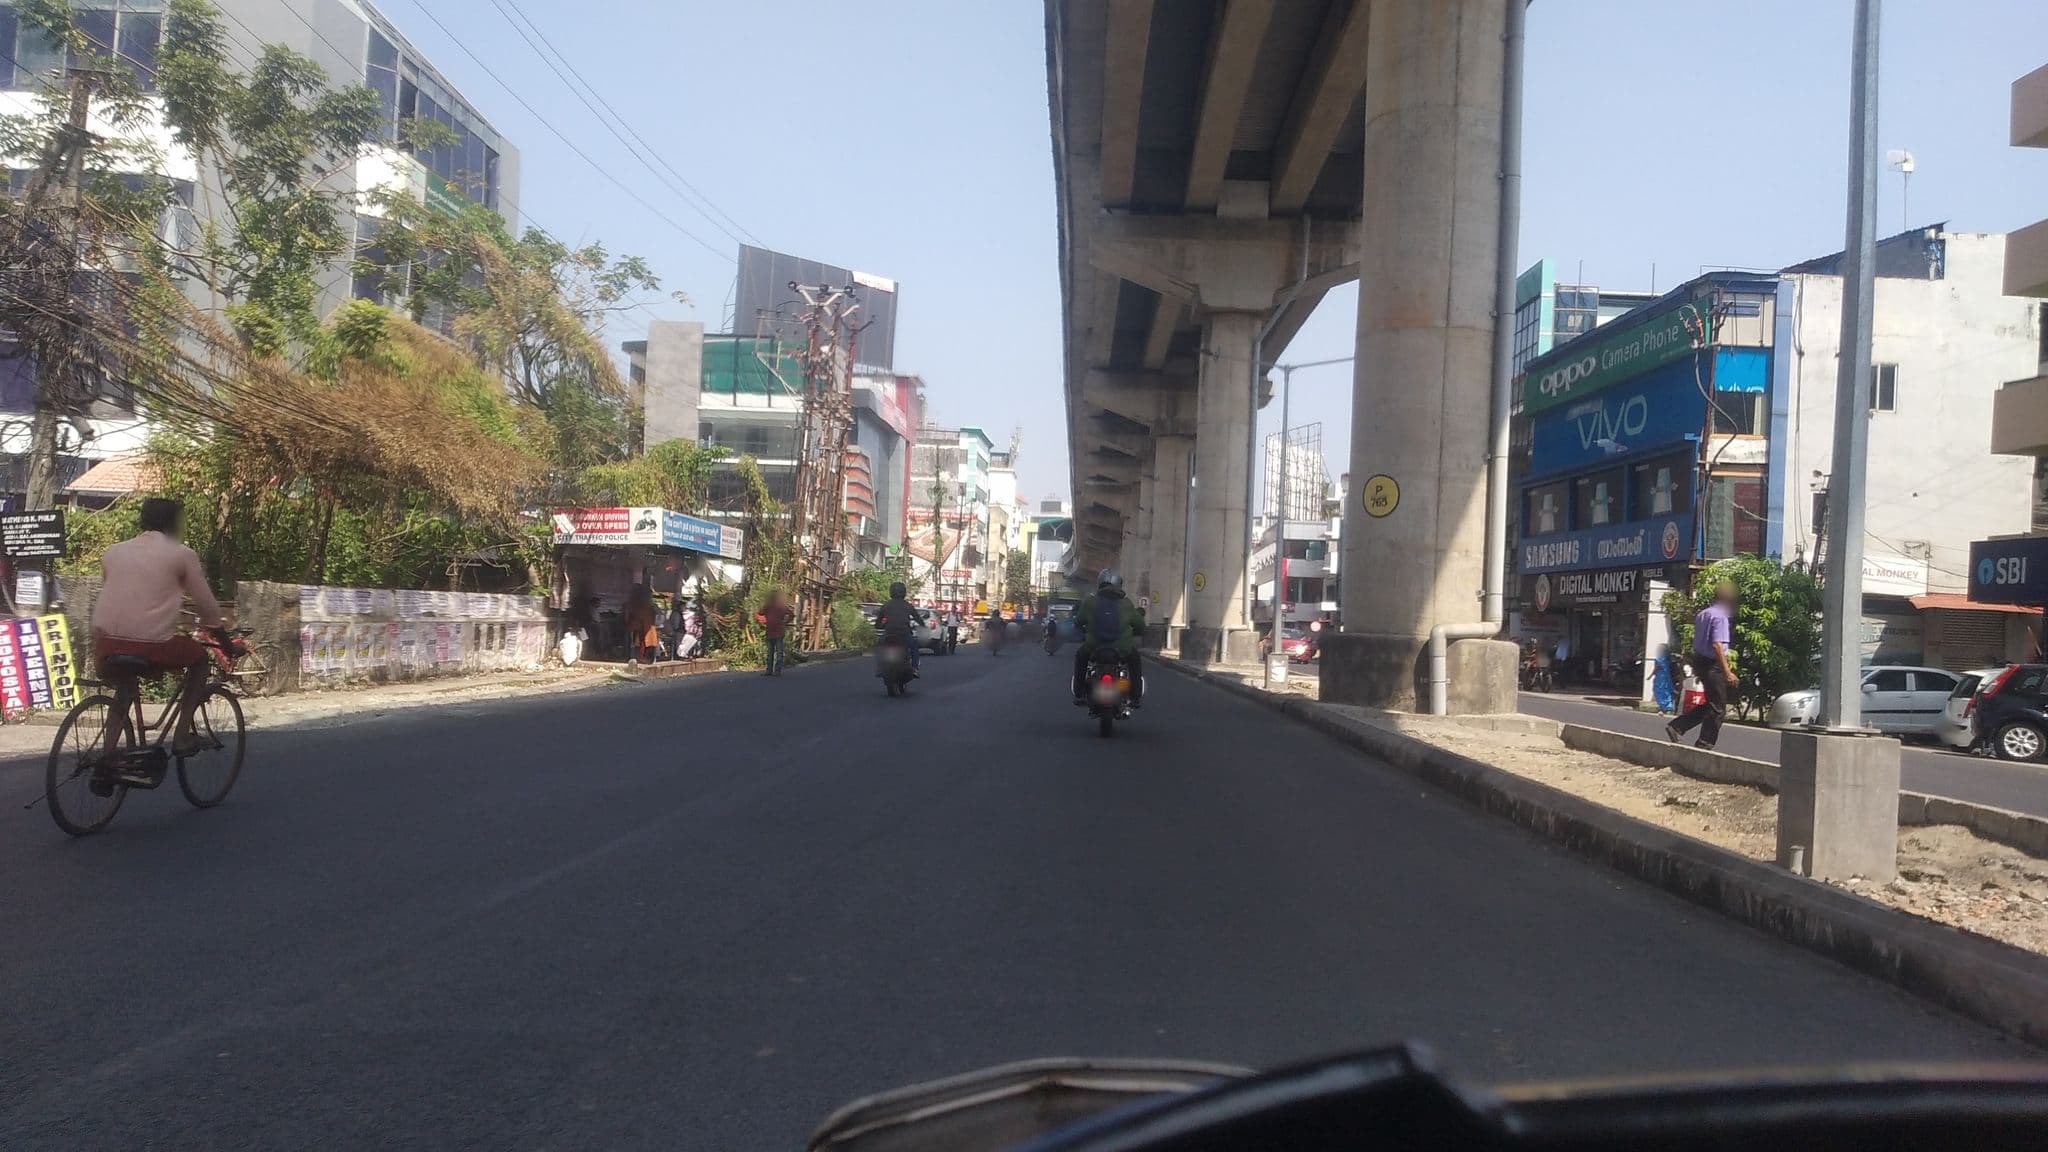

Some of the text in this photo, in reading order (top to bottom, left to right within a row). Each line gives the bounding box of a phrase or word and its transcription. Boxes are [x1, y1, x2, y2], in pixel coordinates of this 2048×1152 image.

[1601, 340, 1640, 371] Camera
[1643, 325, 1680, 353] Phone
[1375, 485, 1383, 495] P
[604, 522, 628, 530] SPEED
[1525, 540, 1580, 568] SAMSUNG
[1559, 574, 1592, 595] DIGITAL
[1594, 570, 1637, 593] MONKEY
[1877, 569, 1919, 579] MONKEY
[1996, 557, 2027, 585] SBI
